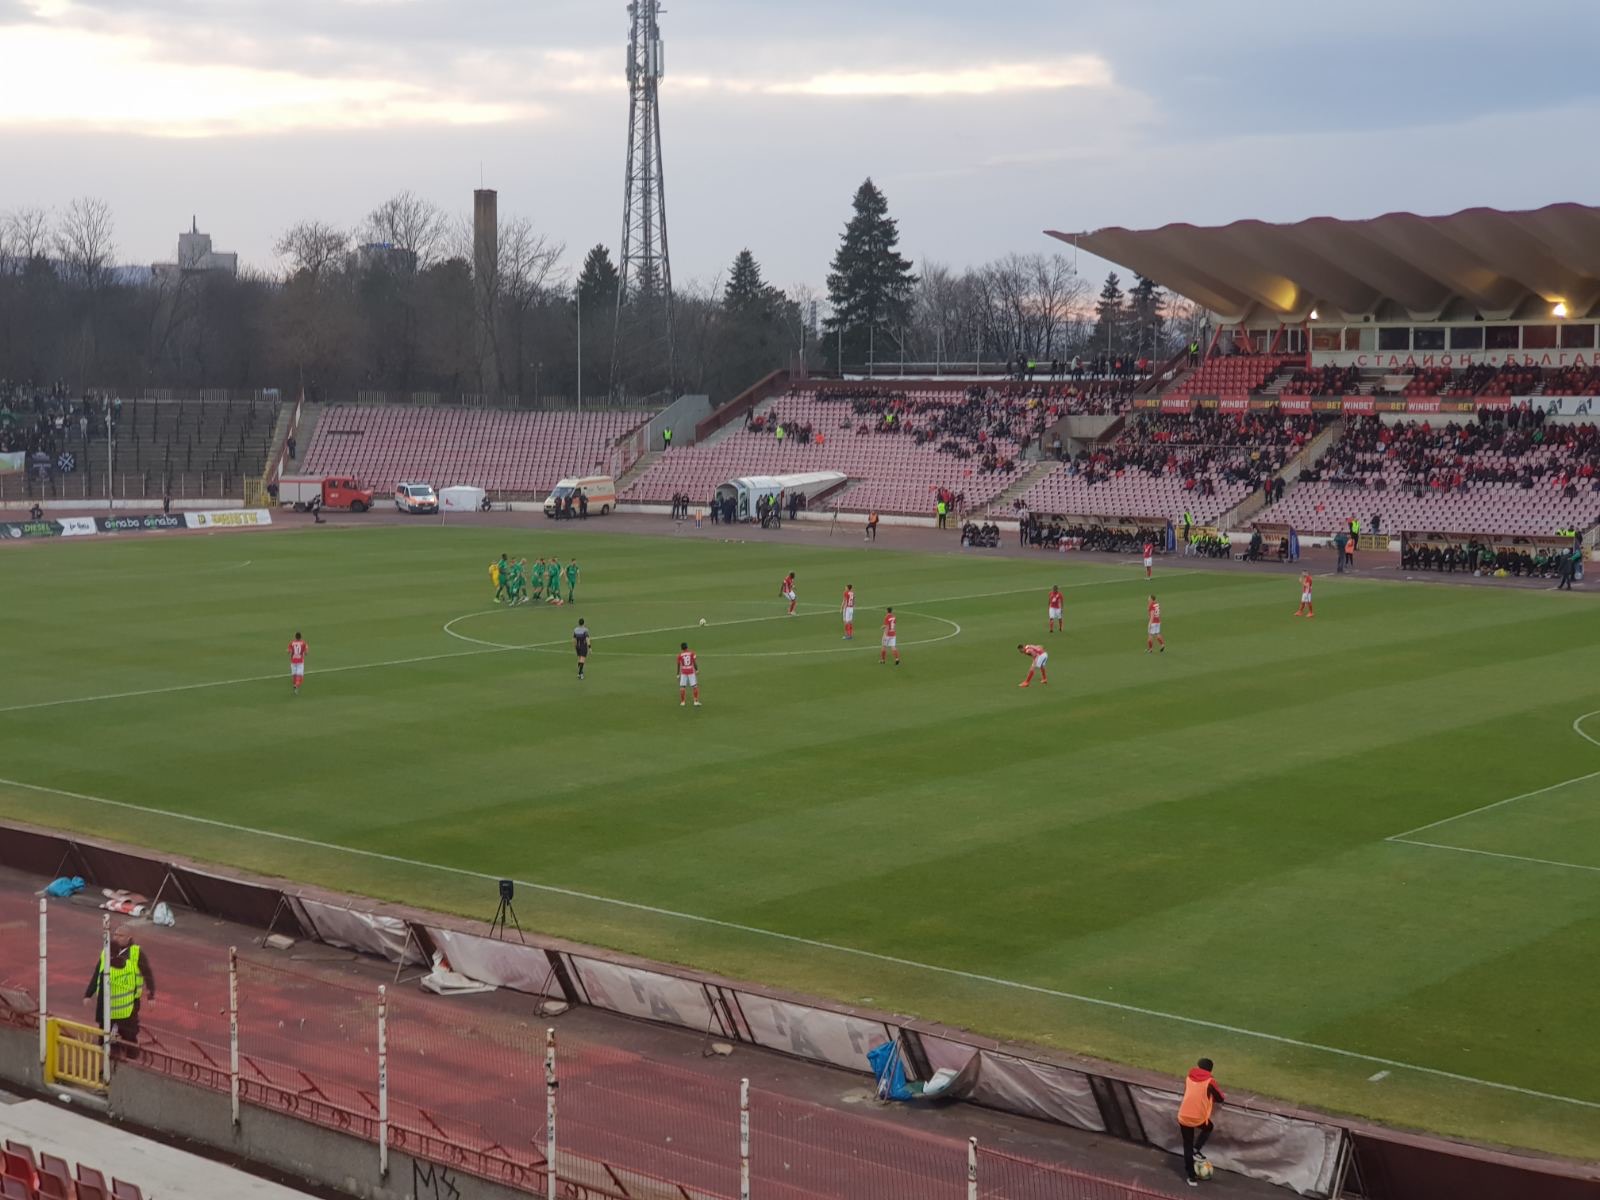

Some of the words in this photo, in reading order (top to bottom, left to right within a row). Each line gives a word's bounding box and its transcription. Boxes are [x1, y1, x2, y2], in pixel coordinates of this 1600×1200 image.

[1162, 400, 1190, 408] WINBET
[1220, 400, 1249, 408] WINBET
[1281, 401, 1310, 409] WINBET
[1343, 401, 1374, 409] WINBET
[1408, 402, 1440, 410] WINBET
[1547, 398, 1563, 416] A1
[1575, 398, 1593, 416] A1
